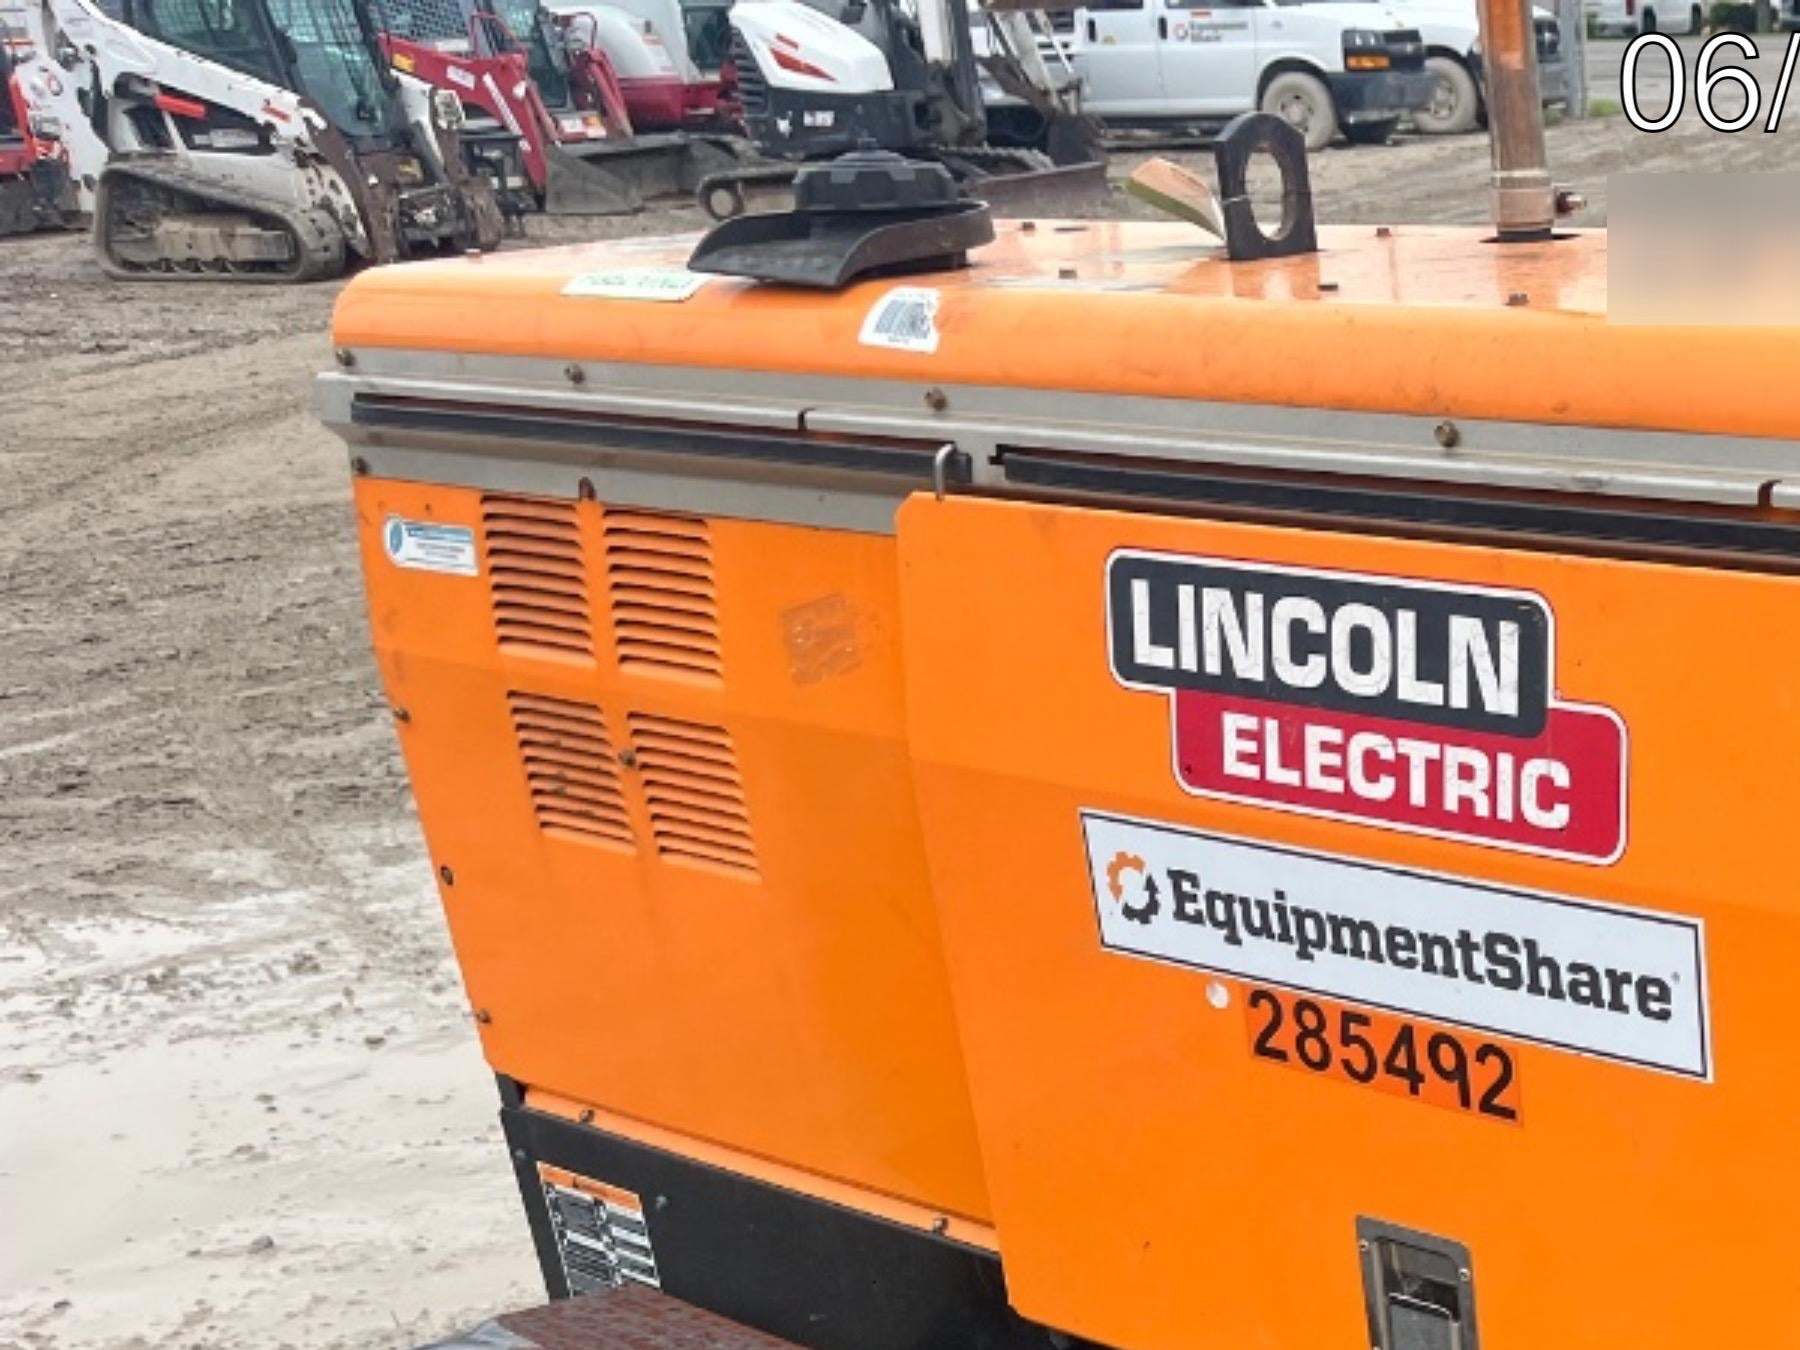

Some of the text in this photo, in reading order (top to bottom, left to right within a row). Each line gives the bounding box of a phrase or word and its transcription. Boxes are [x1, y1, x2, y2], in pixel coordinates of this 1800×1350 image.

[1130, 577, 1520, 717] LINCOLN
[1220, 711, 1571, 830] ELECTRIC
[1166, 867, 1674, 1023] EquipmentShare
[1247, 988, 1518, 1121] 285492
